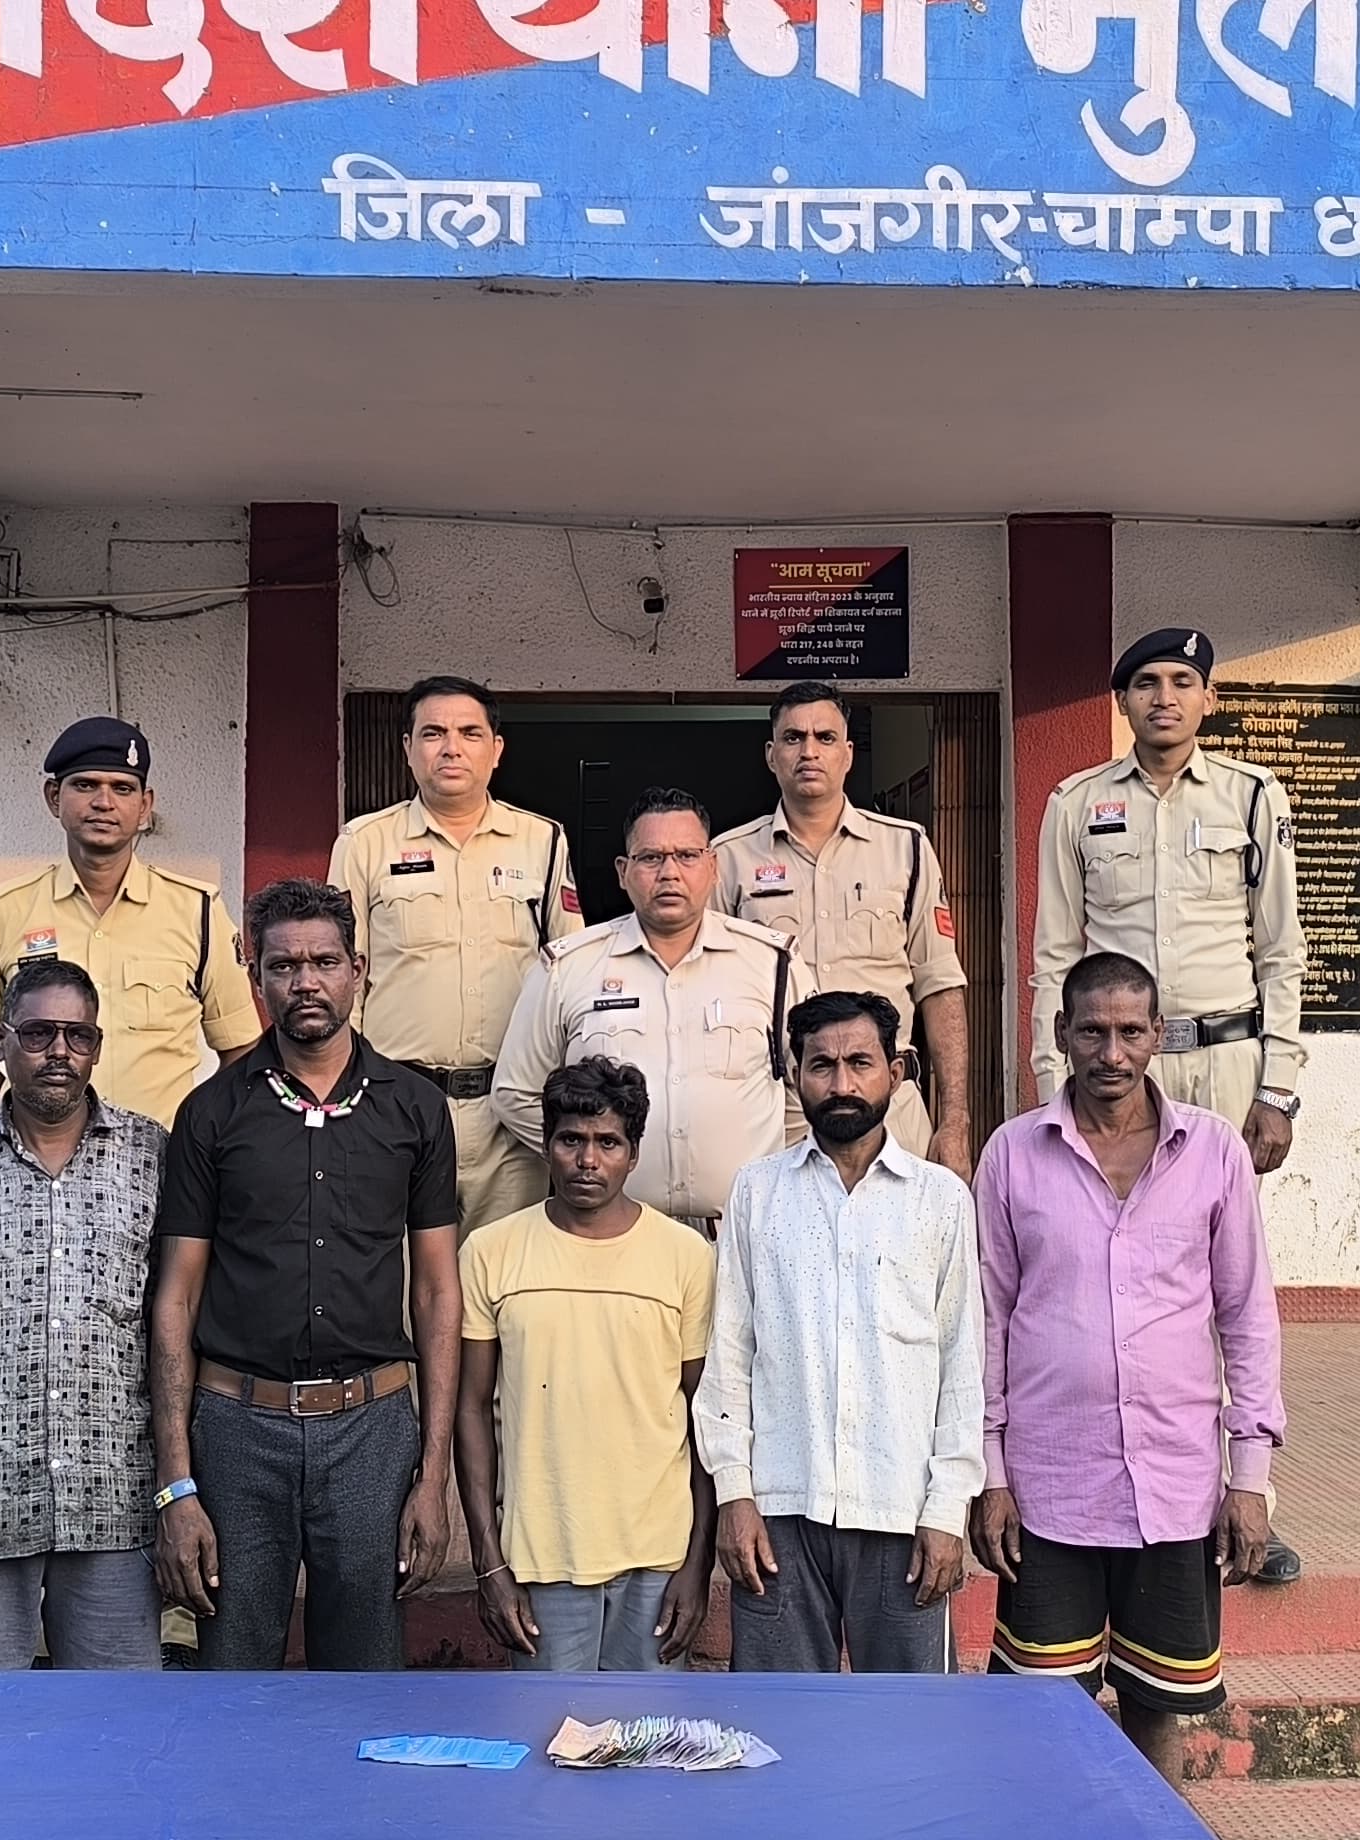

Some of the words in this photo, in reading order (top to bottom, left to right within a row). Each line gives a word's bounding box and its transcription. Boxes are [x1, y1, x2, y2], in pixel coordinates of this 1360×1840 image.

[322, 152, 541, 248] जिला
[699, 164, 1285, 268] जांजगीर-चाम्पा
[748, 591, 780, 602] भारतीय
[782, 593, 803, 602] न्याय
[805, 591, 830, 602] संहिता
[831, 593, 852, 601] 2023
[853, 591, 862, 601] के
[864, 592, 894, 604] अनुसार
[741, 608, 759, 618] थाने
[760, 607, 769, 618] में
[788, 606, 811, 617] रिपोर्ट
[813, 608, 823, 617] या
[876, 608, 902, 617] कराना
[834, 622, 852, 633] जाने
[854, 624, 865, 633] पर
[780, 641, 797, 649] धारा
[835, 637, 843, 648] के
[845, 640, 863, 649] तहत
[821, 655, 849, 664] अपराध
[1241, 713, 1298, 733] लोकार्पण
